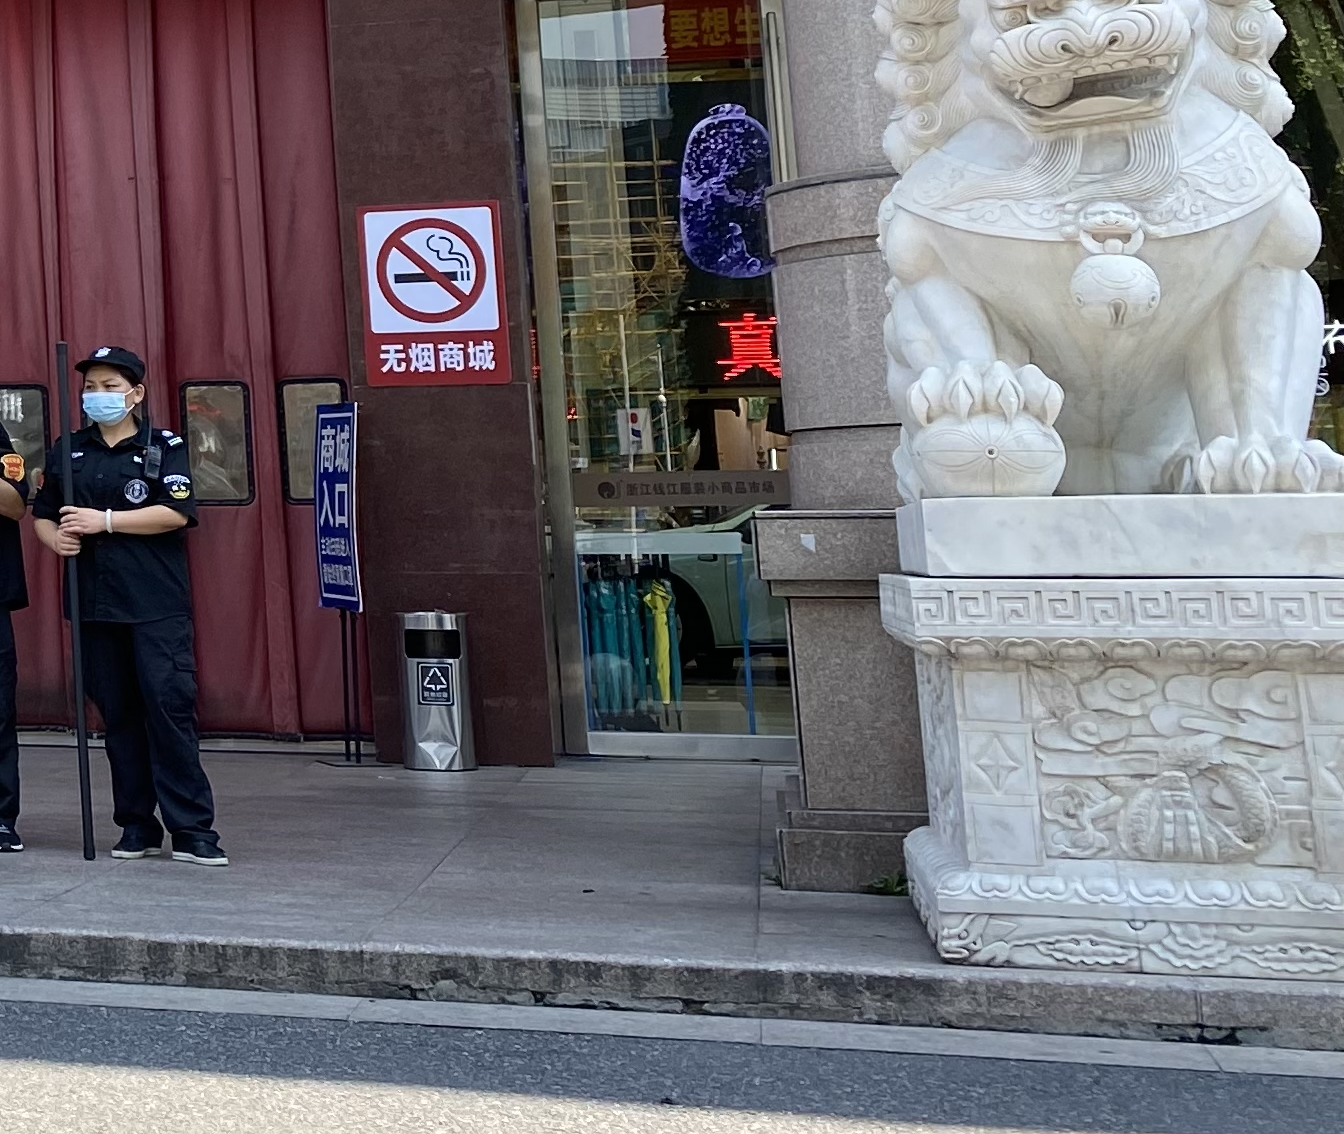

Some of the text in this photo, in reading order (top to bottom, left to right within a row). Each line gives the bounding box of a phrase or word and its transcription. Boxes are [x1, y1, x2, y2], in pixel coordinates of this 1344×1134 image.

[379, 340, 496, 373] 无烟商城
[320, 425, 350, 474] 商城
[320, 480, 348, 529] 入口
